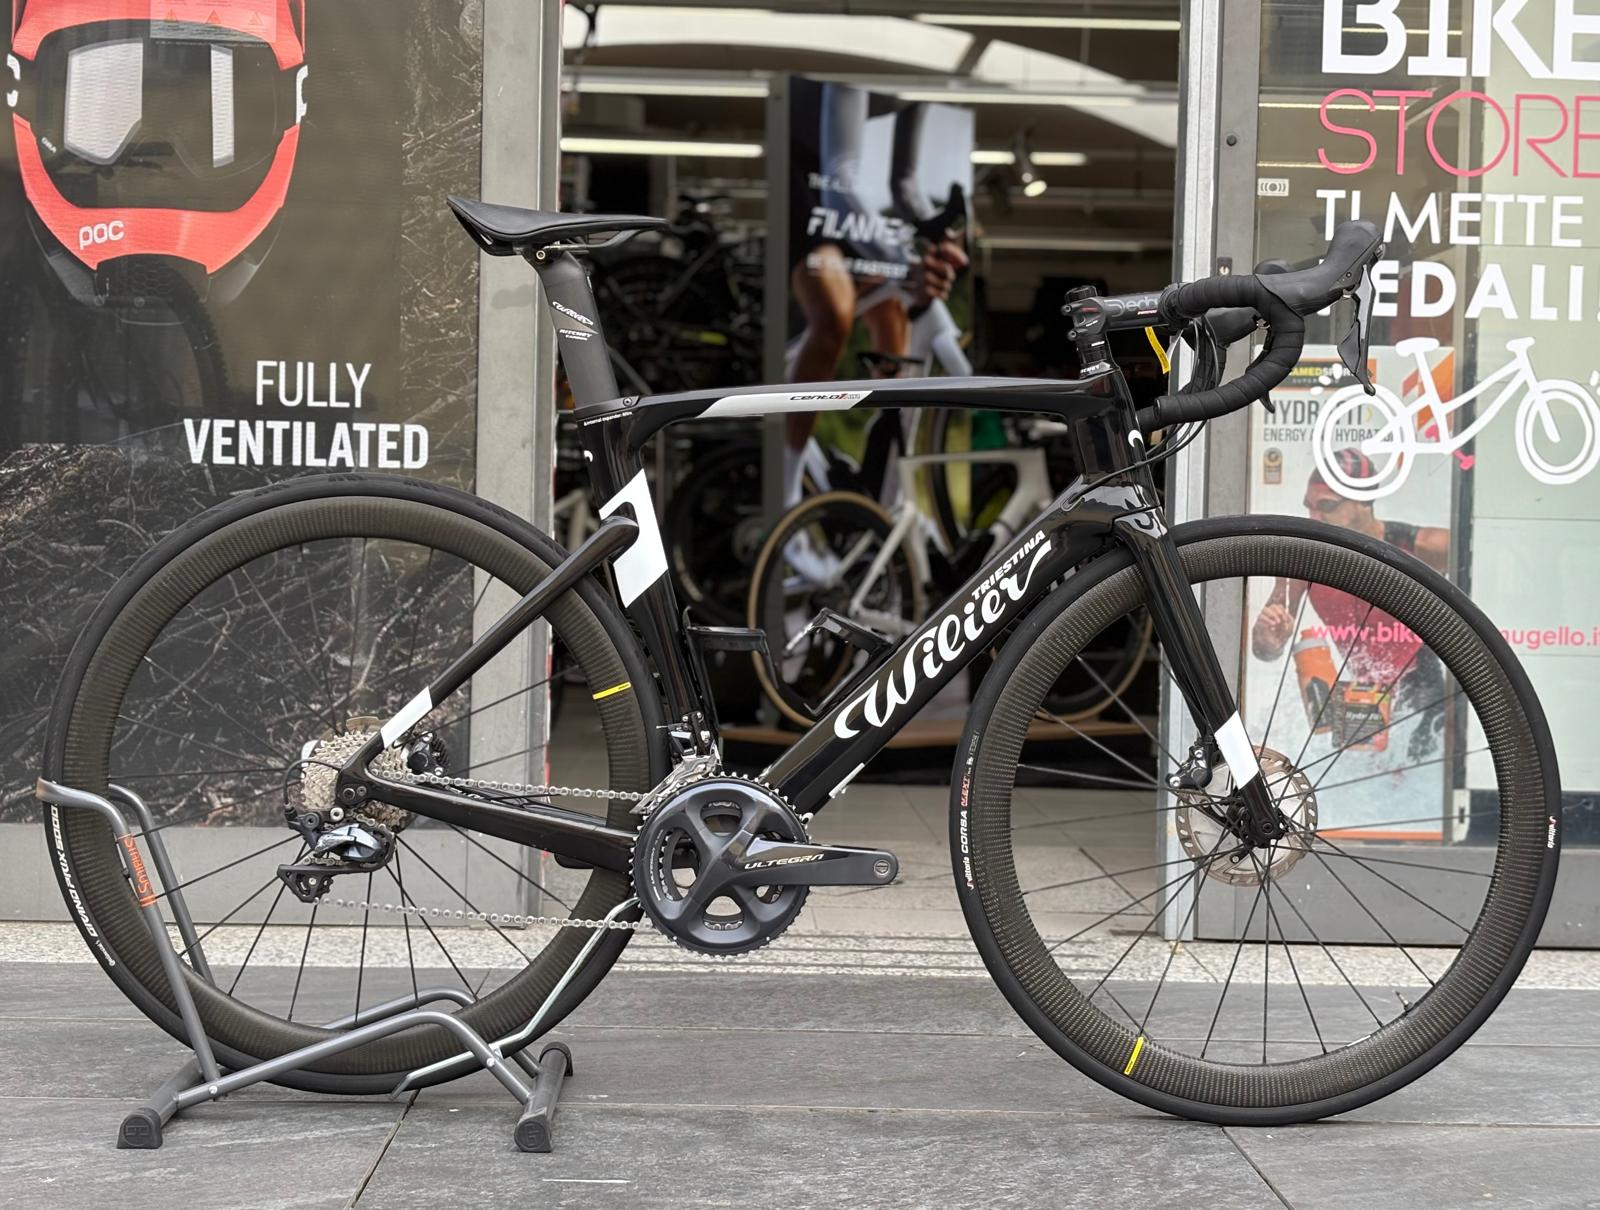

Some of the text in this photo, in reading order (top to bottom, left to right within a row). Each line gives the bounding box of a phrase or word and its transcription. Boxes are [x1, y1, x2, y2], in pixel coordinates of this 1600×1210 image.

[1321, 0, 1600, 81] BIKE
[1317, 88, 1600, 178] STORE
[1316, 189, 1584, 248] TI METTE
[1317, 258, 1600, 322] EDALI
[255, 360, 372, 409] FULLY
[183, 417, 429, 470] VENTILATED
[1263, 428, 1307, 441] ENERGY
[971, 529, 1046, 600] TRIESTINA
[833, 539, 1052, 739] Wilier
[50, 806, 65, 852] 5000
[960, 810, 968, 853] CORSA
[58, 851, 77, 891] PRIX
[744, 853, 825, 870] ULTEGRA
[69, 888, 99, 938] GRAND
